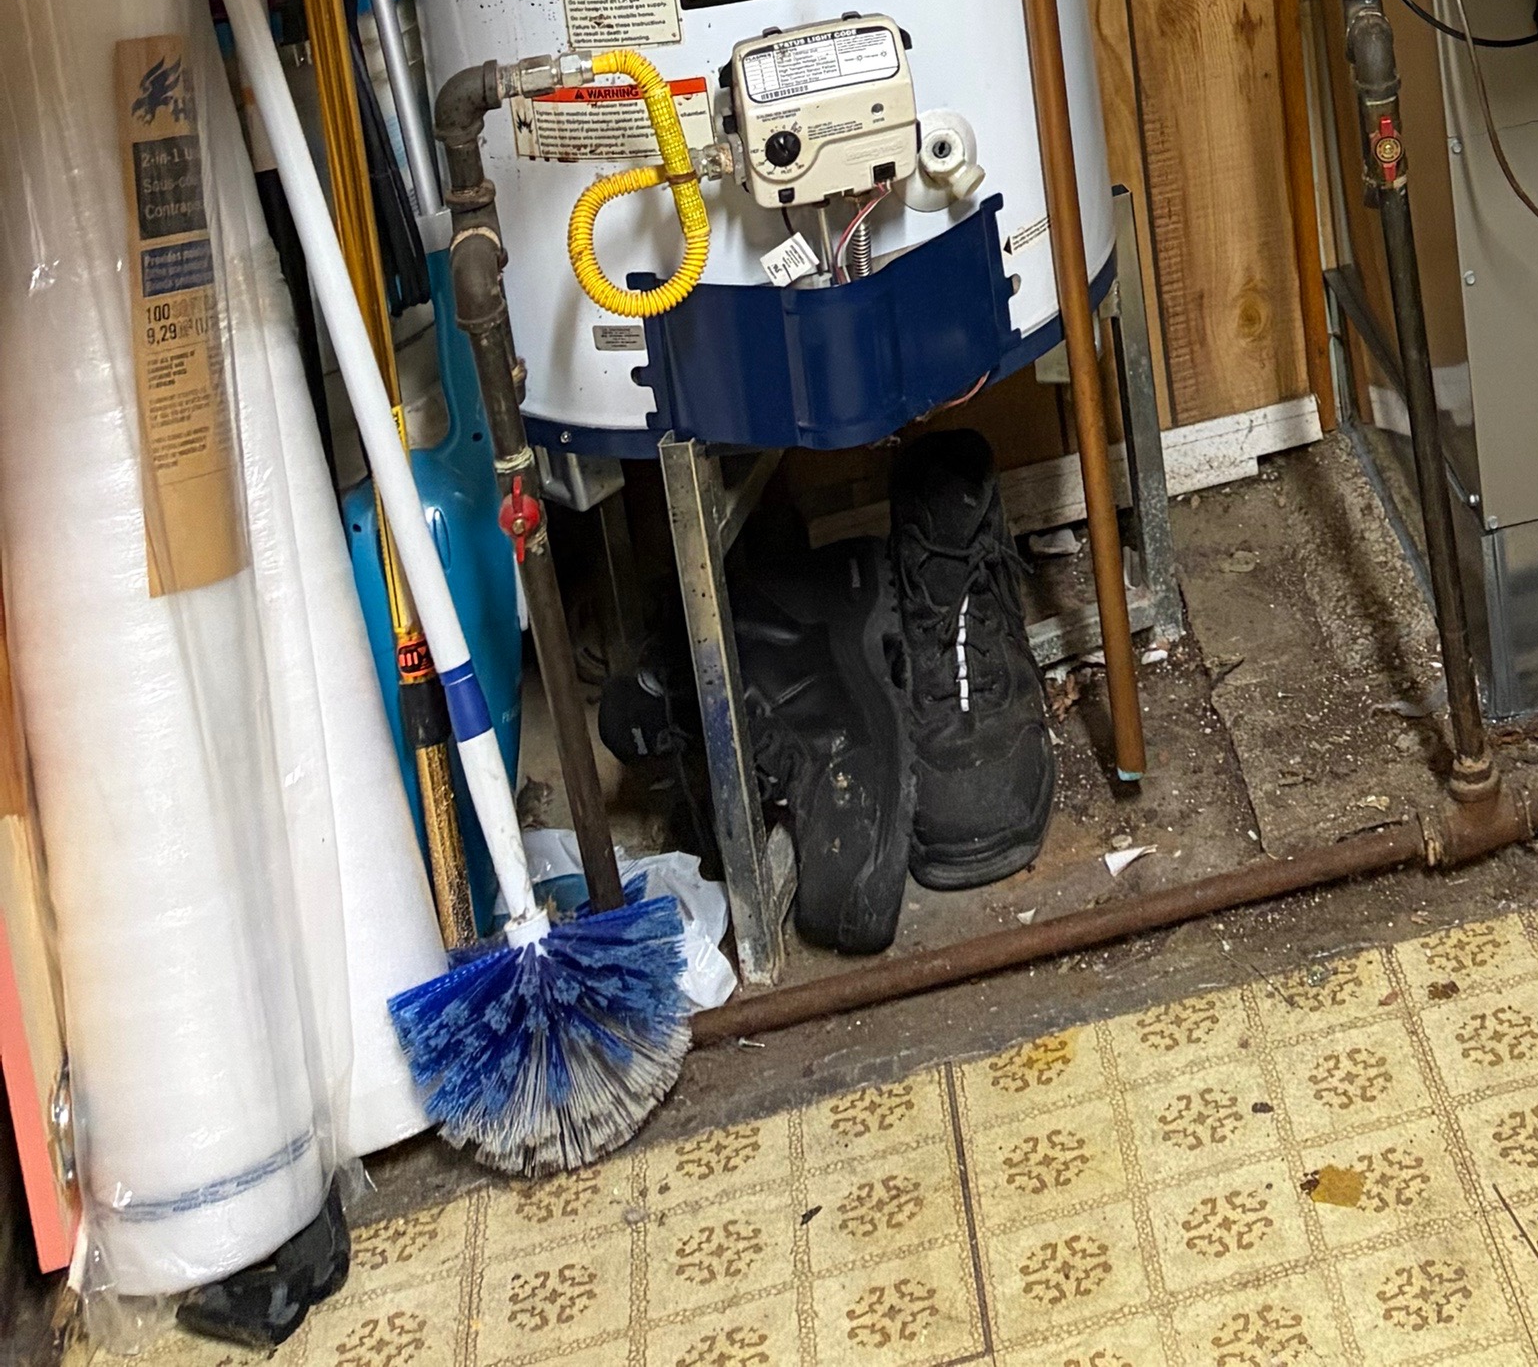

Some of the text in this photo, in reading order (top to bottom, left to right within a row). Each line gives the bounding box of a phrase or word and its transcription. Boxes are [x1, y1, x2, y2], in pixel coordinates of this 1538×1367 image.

[773, 28, 857, 51] STATUS LIGHT CODE
[587, 84, 639, 101] WARNING
[141, 148, 178, 168] 2-in-1
[146, 303, 170, 324] 100
[147, 323, 177, 345] 9,29
